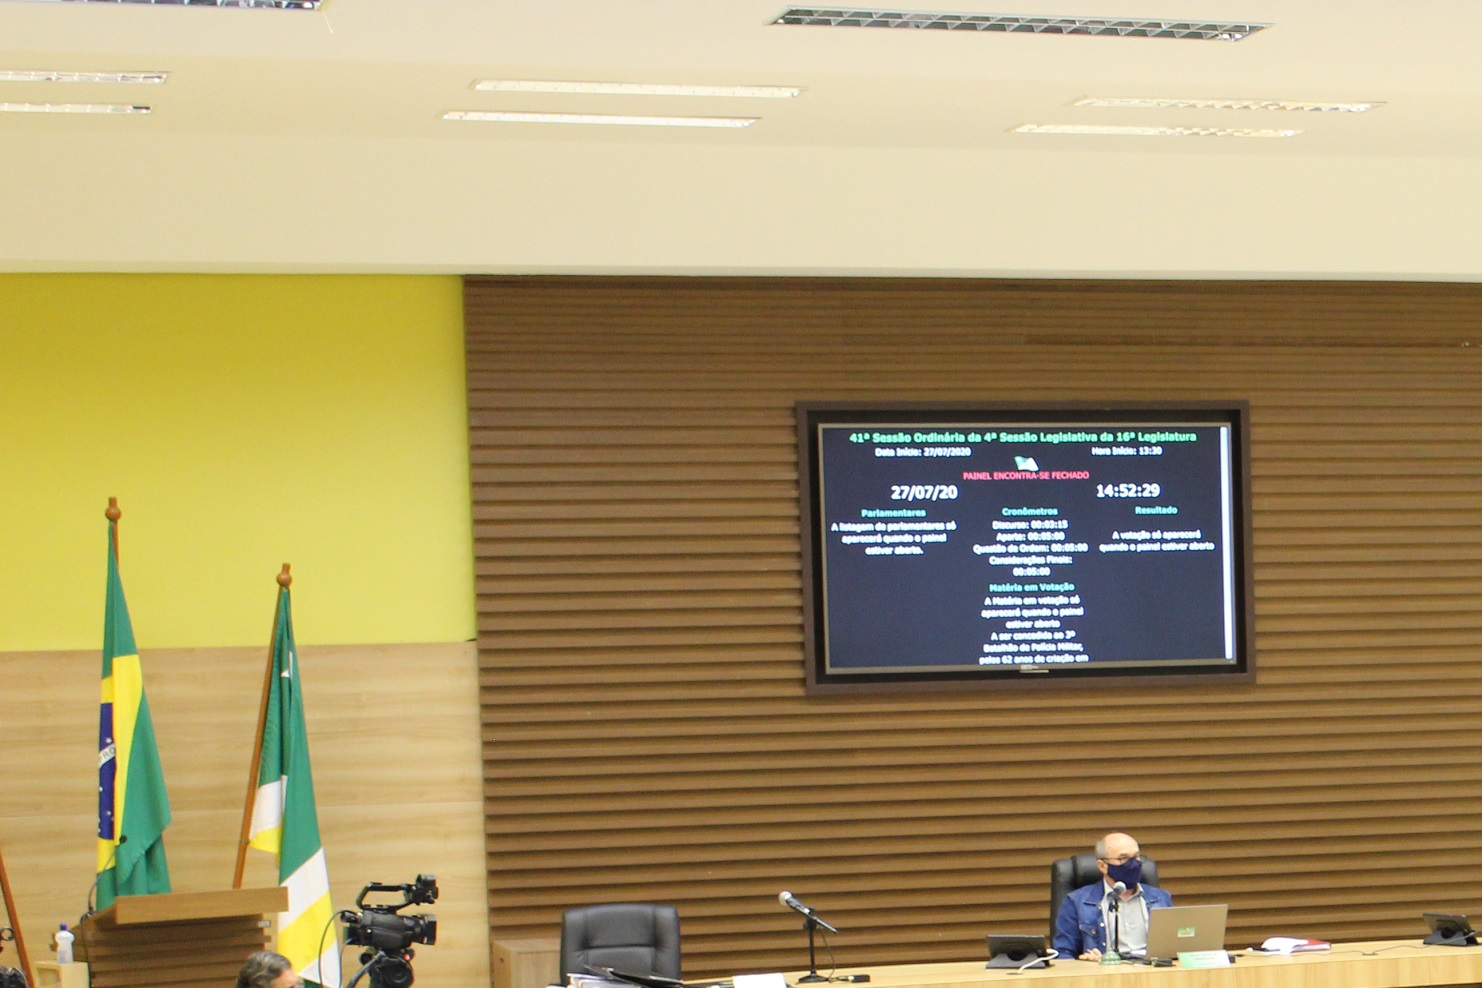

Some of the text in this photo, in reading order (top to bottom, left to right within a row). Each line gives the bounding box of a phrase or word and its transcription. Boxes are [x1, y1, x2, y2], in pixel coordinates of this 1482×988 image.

[872, 432, 911, 443] Sessão
[913, 432, 965, 443] Ordinária
[967, 432, 981, 442] da
[1000, 432, 1037, 442] Sessão
[1040, 432, 1098, 444] Legislativa
[1100, 432, 1114, 442] da
[1138, 432, 1197, 443] Legislatura
[875, 448, 895, 457] Data
[923, 447, 972, 457] 27/07/2020
[1091, 447, 1111, 455] Hora
[1139, 446, 1163, 455] 13:30
[963, 471, 1089, 480] PAINEL ENCONTRA-SE FECHADO
[891, 485, 958, 501] 27/07/20
[1096, 483, 1160, 498] 14:52:29
[861, 509, 926, 518] Parlamentares
[1002, 507, 1058, 516] Cronômetros
[1135, 505, 1178, 514] Resultado
[989, 582, 1075, 593] Matéria em Votação
